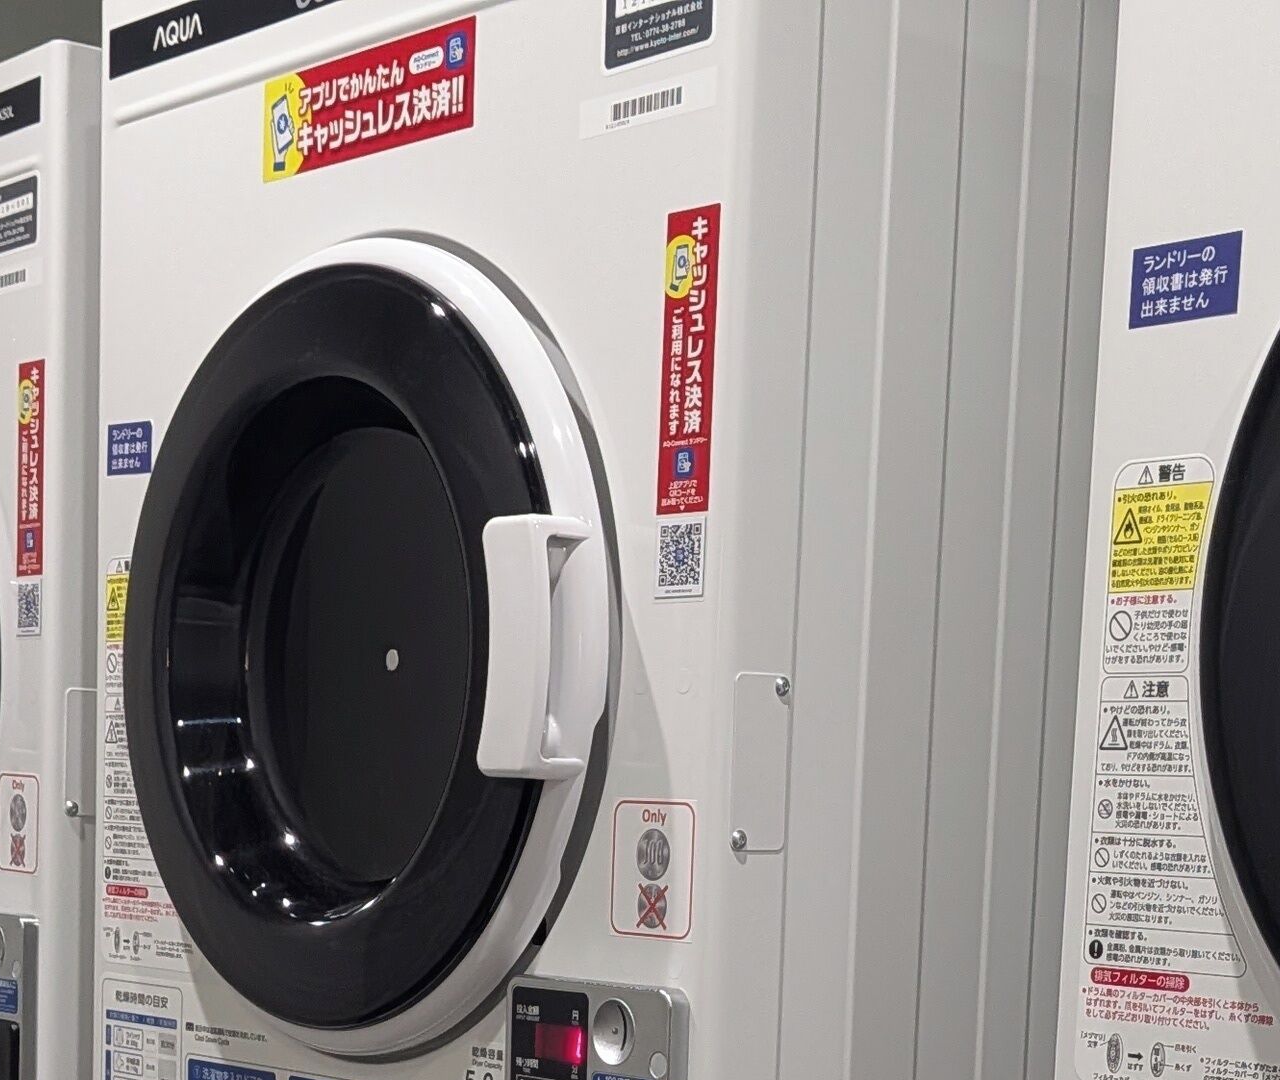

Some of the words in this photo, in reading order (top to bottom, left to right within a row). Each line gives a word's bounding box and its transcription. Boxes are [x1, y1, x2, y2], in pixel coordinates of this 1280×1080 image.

[152, 12, 203, 51] AQUA
[298, 59, 405, 114] アプリでかんたん
[1143, 246, 1215, 273] ランドリーの
[1142, 265, 1228, 296] 領収書は発行
[1140, 291, 1209, 319] 出来ません
[683, 216, 708, 434] キャッシュレス決済
[668, 306, 684, 435] ご利用になれます
[1158, 463, 1185, 483] 警告
[1142, 680, 1169, 698] 注意
[642, 808, 667, 826] Only
[115, 990, 168, 1008] 乾燥時間の目安
[472, 1046, 503, 1061] 乾燥容量
